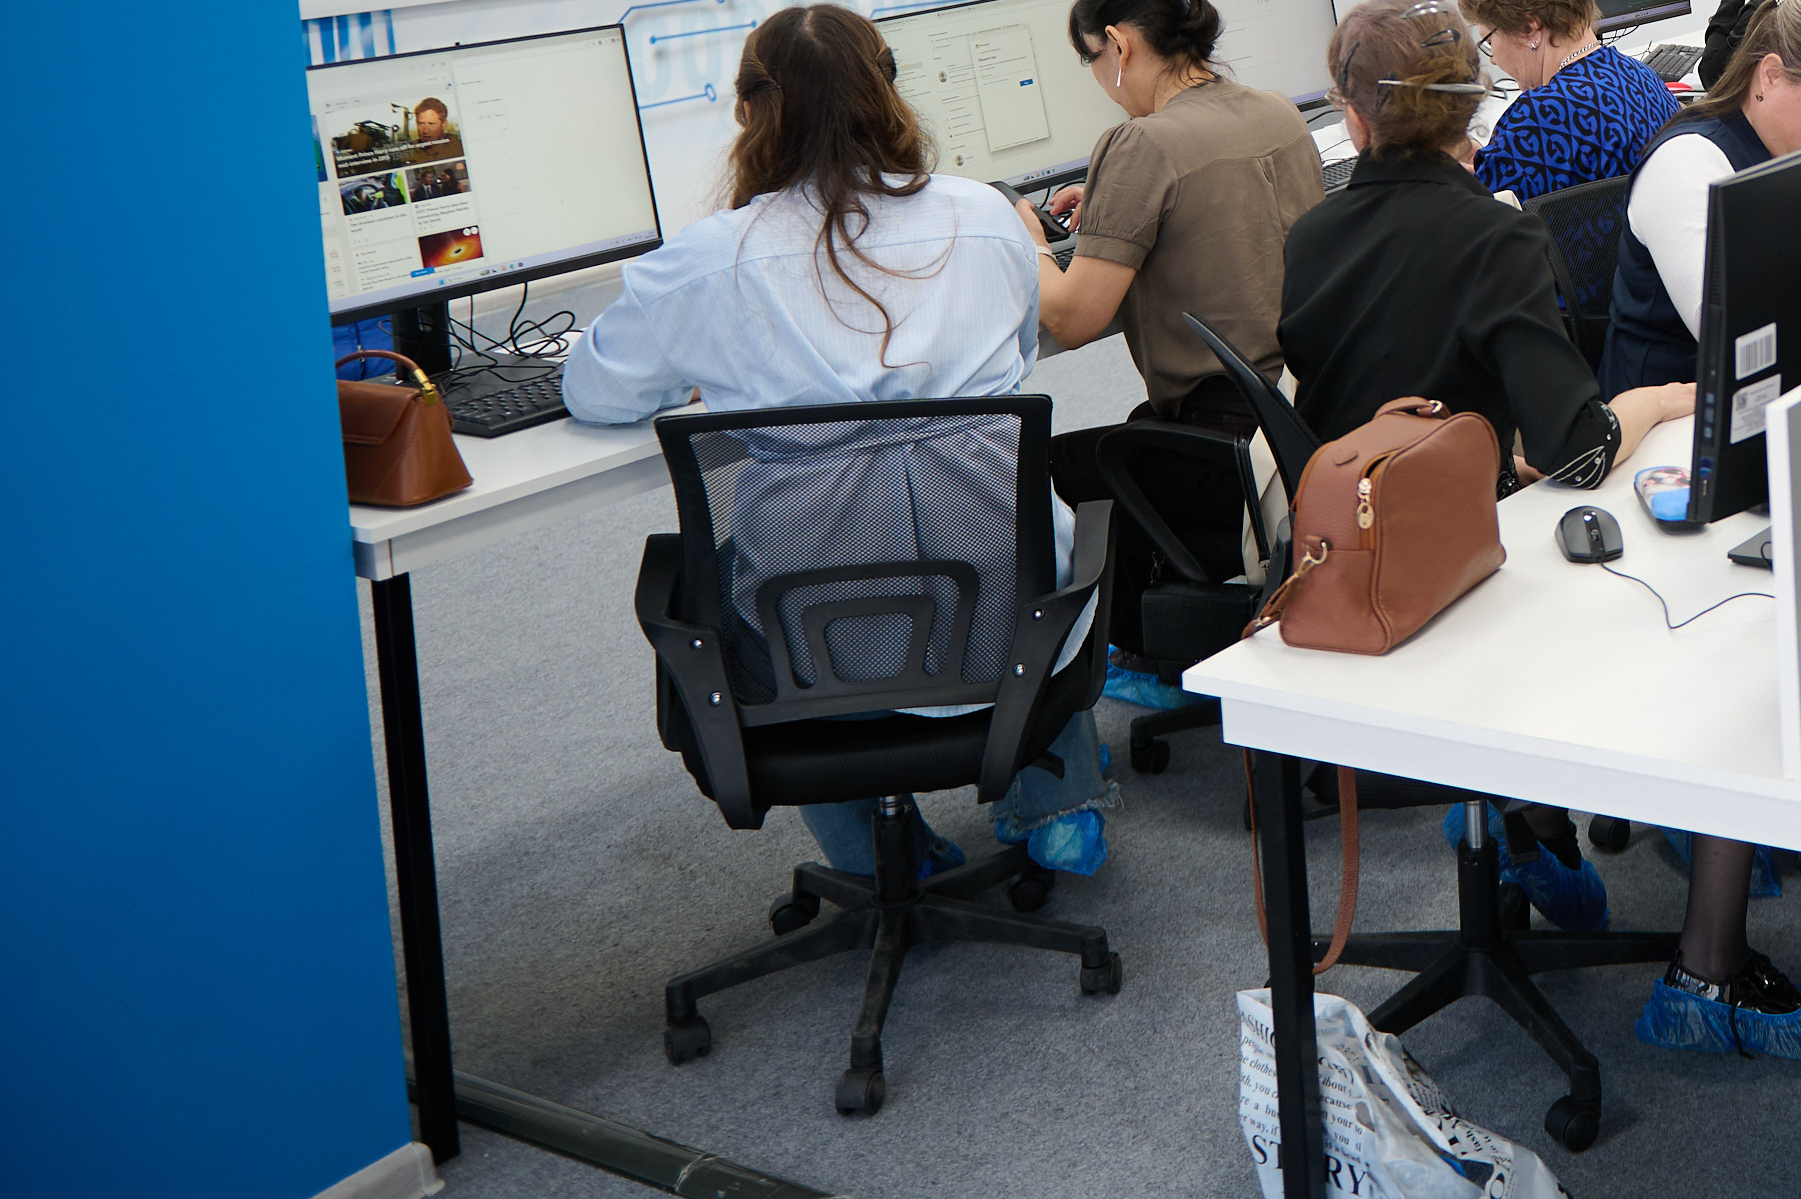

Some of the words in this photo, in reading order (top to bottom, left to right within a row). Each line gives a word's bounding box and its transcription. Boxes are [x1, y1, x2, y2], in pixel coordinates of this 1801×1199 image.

[1240, 1011, 1275, 1049] ASHI
[1252, 1082, 1270, 1093] you
[1320, 1093, 1352, 1110] ecause
[1331, 1113, 1353, 1129] your
